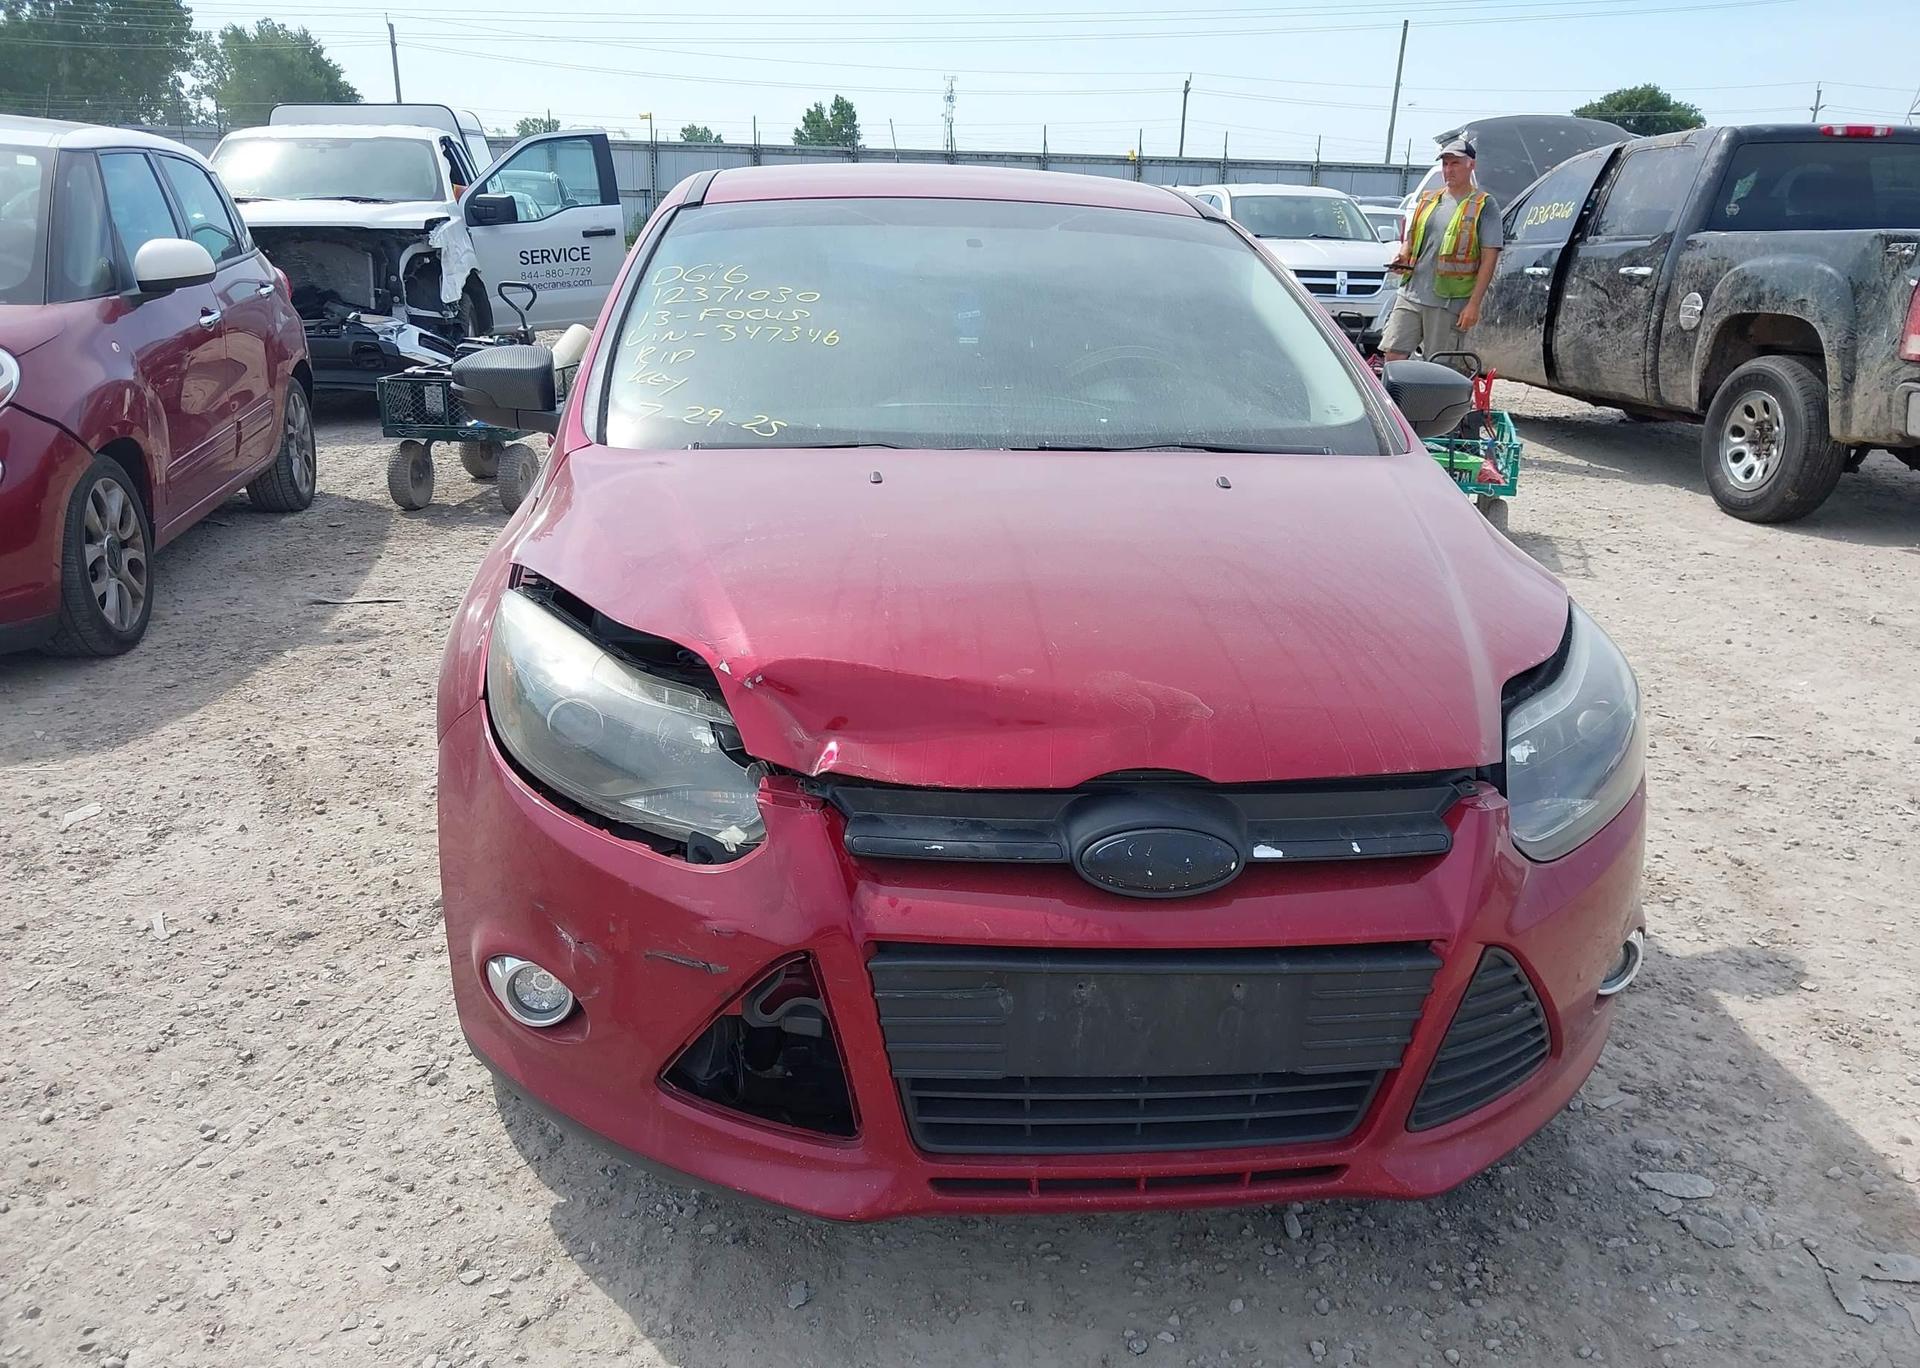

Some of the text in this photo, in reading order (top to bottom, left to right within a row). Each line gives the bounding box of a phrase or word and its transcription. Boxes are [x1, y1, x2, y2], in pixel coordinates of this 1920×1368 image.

[519, 246, 591, 266] SERVICE
[520, 266, 592, 280] 844-880-7729
[521, 278, 593, 292] necranes.com
[652, 286, 821, 307] 12371030
